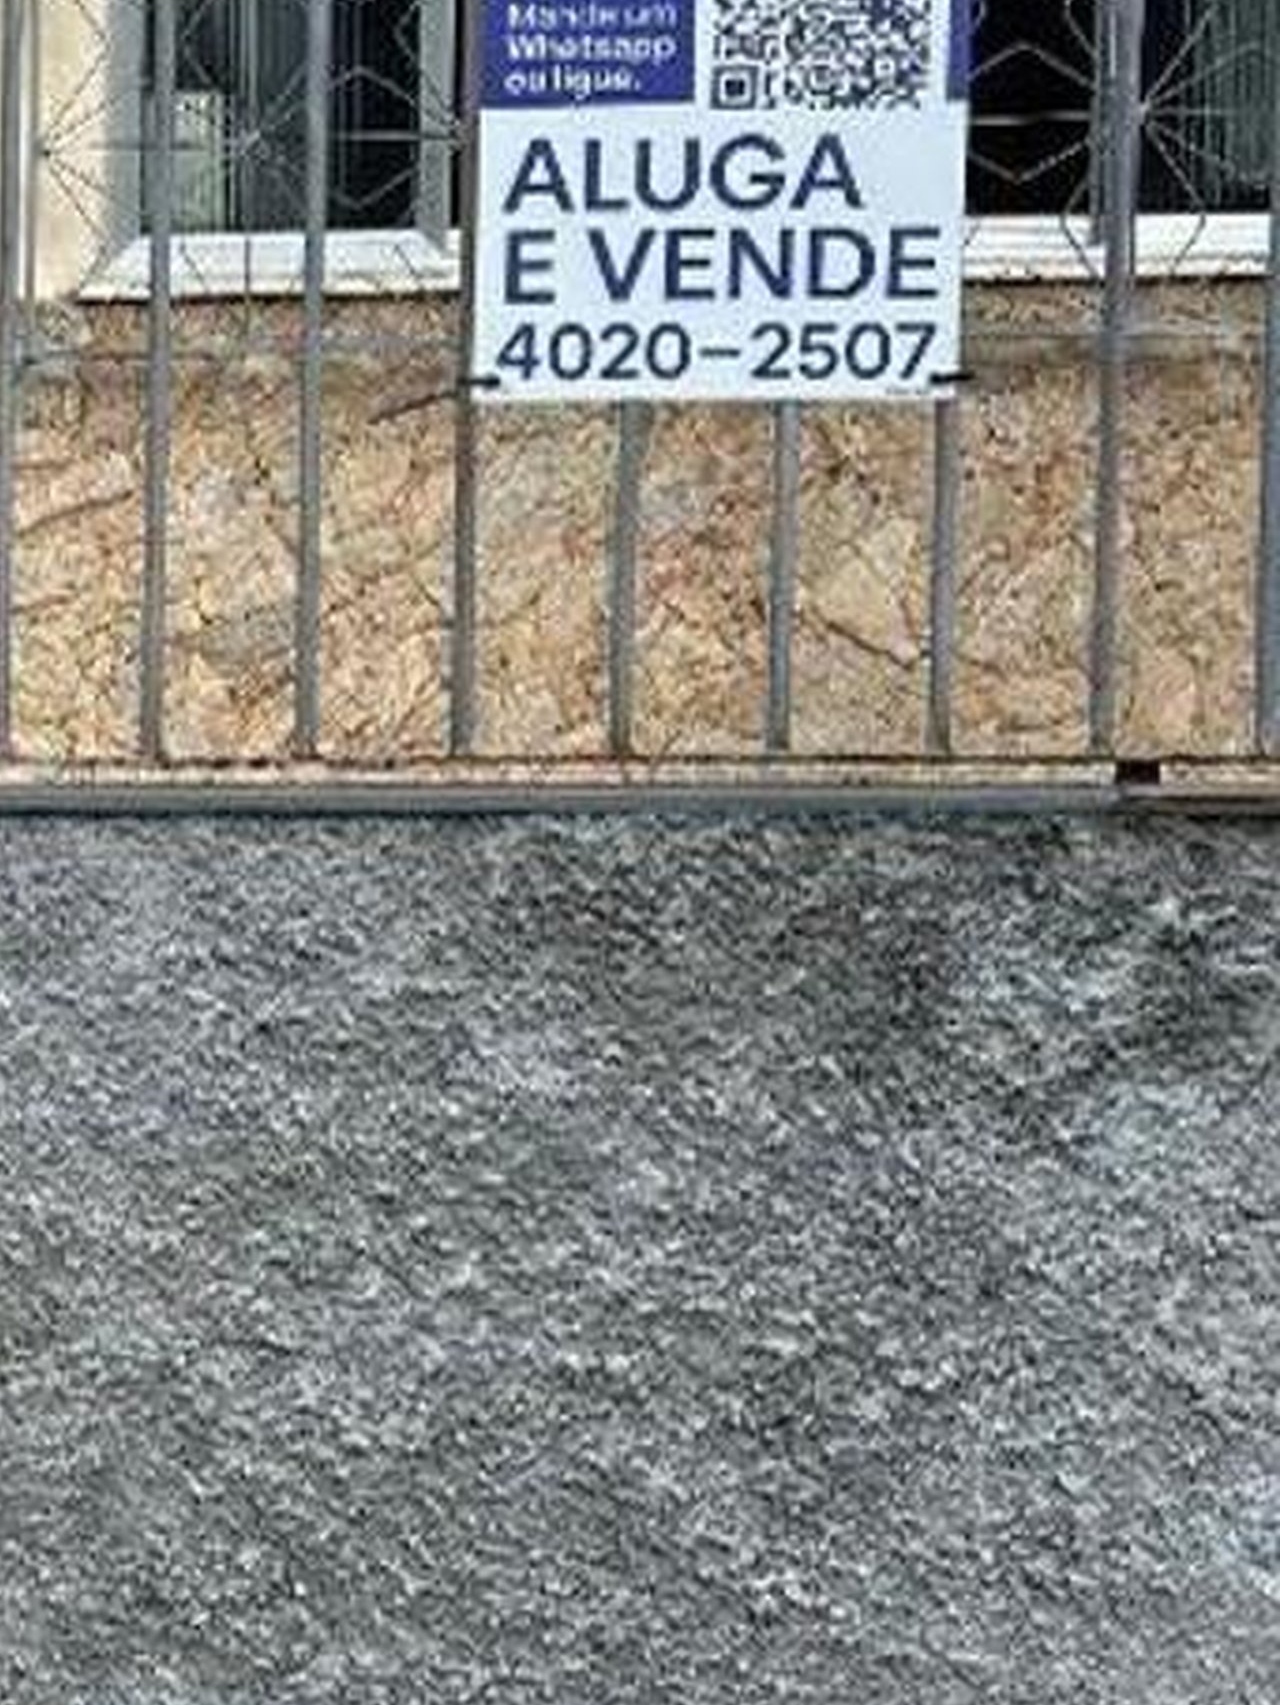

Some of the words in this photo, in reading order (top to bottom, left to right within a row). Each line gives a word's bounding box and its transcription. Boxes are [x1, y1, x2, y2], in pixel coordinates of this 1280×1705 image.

[502, 132, 865, 214] ALUGA
[503, 228, 556, 304] E
[586, 225, 942, 300] VENDE
[495, 321, 939, 381] 4020-2507
